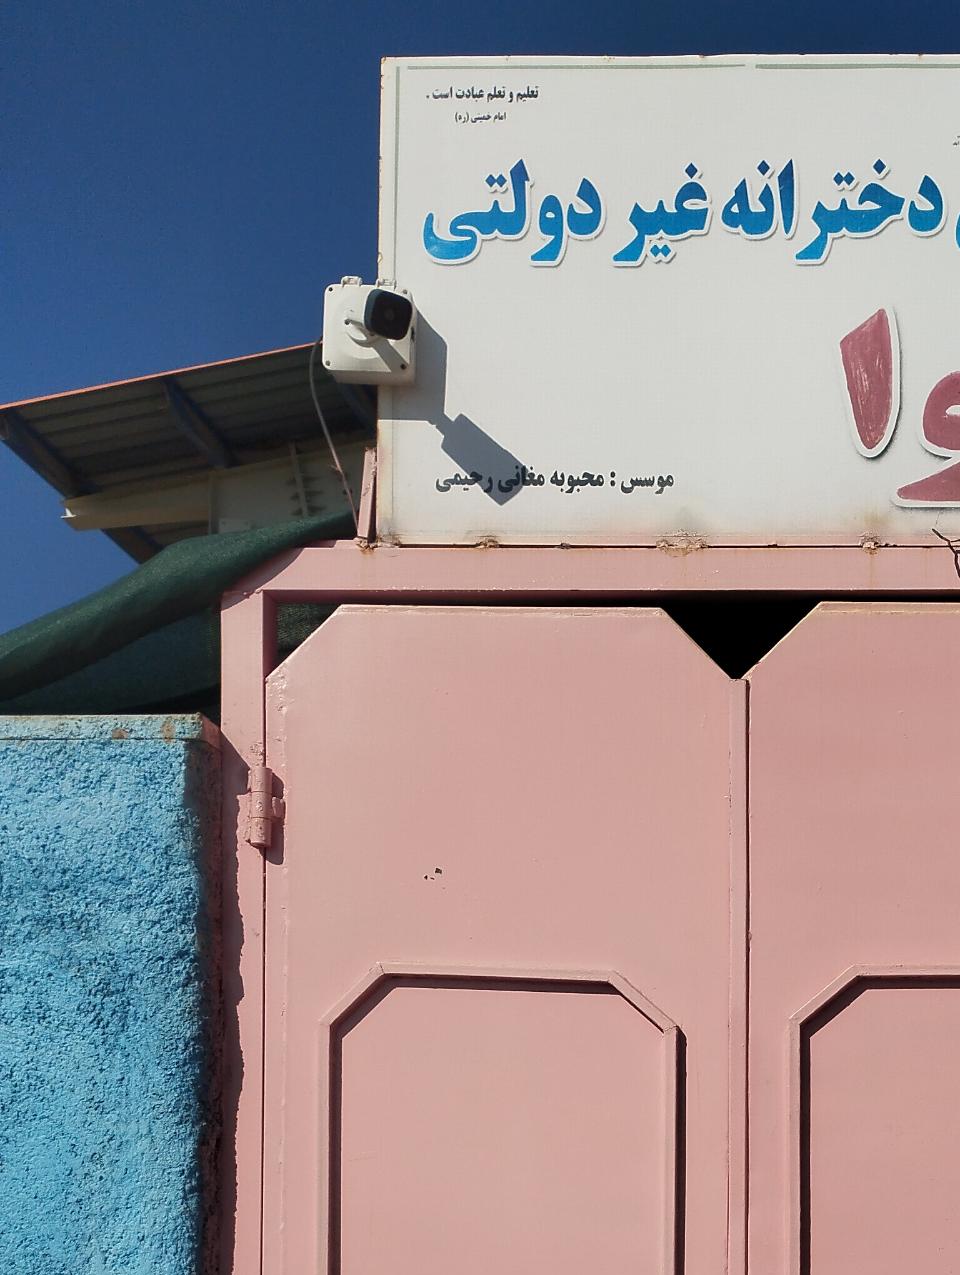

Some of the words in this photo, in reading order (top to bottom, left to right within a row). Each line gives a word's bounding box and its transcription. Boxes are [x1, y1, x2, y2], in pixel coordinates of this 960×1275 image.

[455, 86, 485, 102] عبادت
[486, 86, 506, 103] تعلم
[507, 91, 514, 103] و
[515, 85, 539, 103] تعلیم
[454, 111, 470, 123] (ره)
[470, 112, 492, 123] خمینی
[493, 111, 507, 121] امام
[422, 159, 602, 262] دولتی
[611, 162, 709, 264] غیر
[721, 158, 944, 262] دخترانه
[435, 469, 494, 494] رحیمی
[549, 469, 605, 494] محبوبه
[620, 469, 674, 495] موسس
